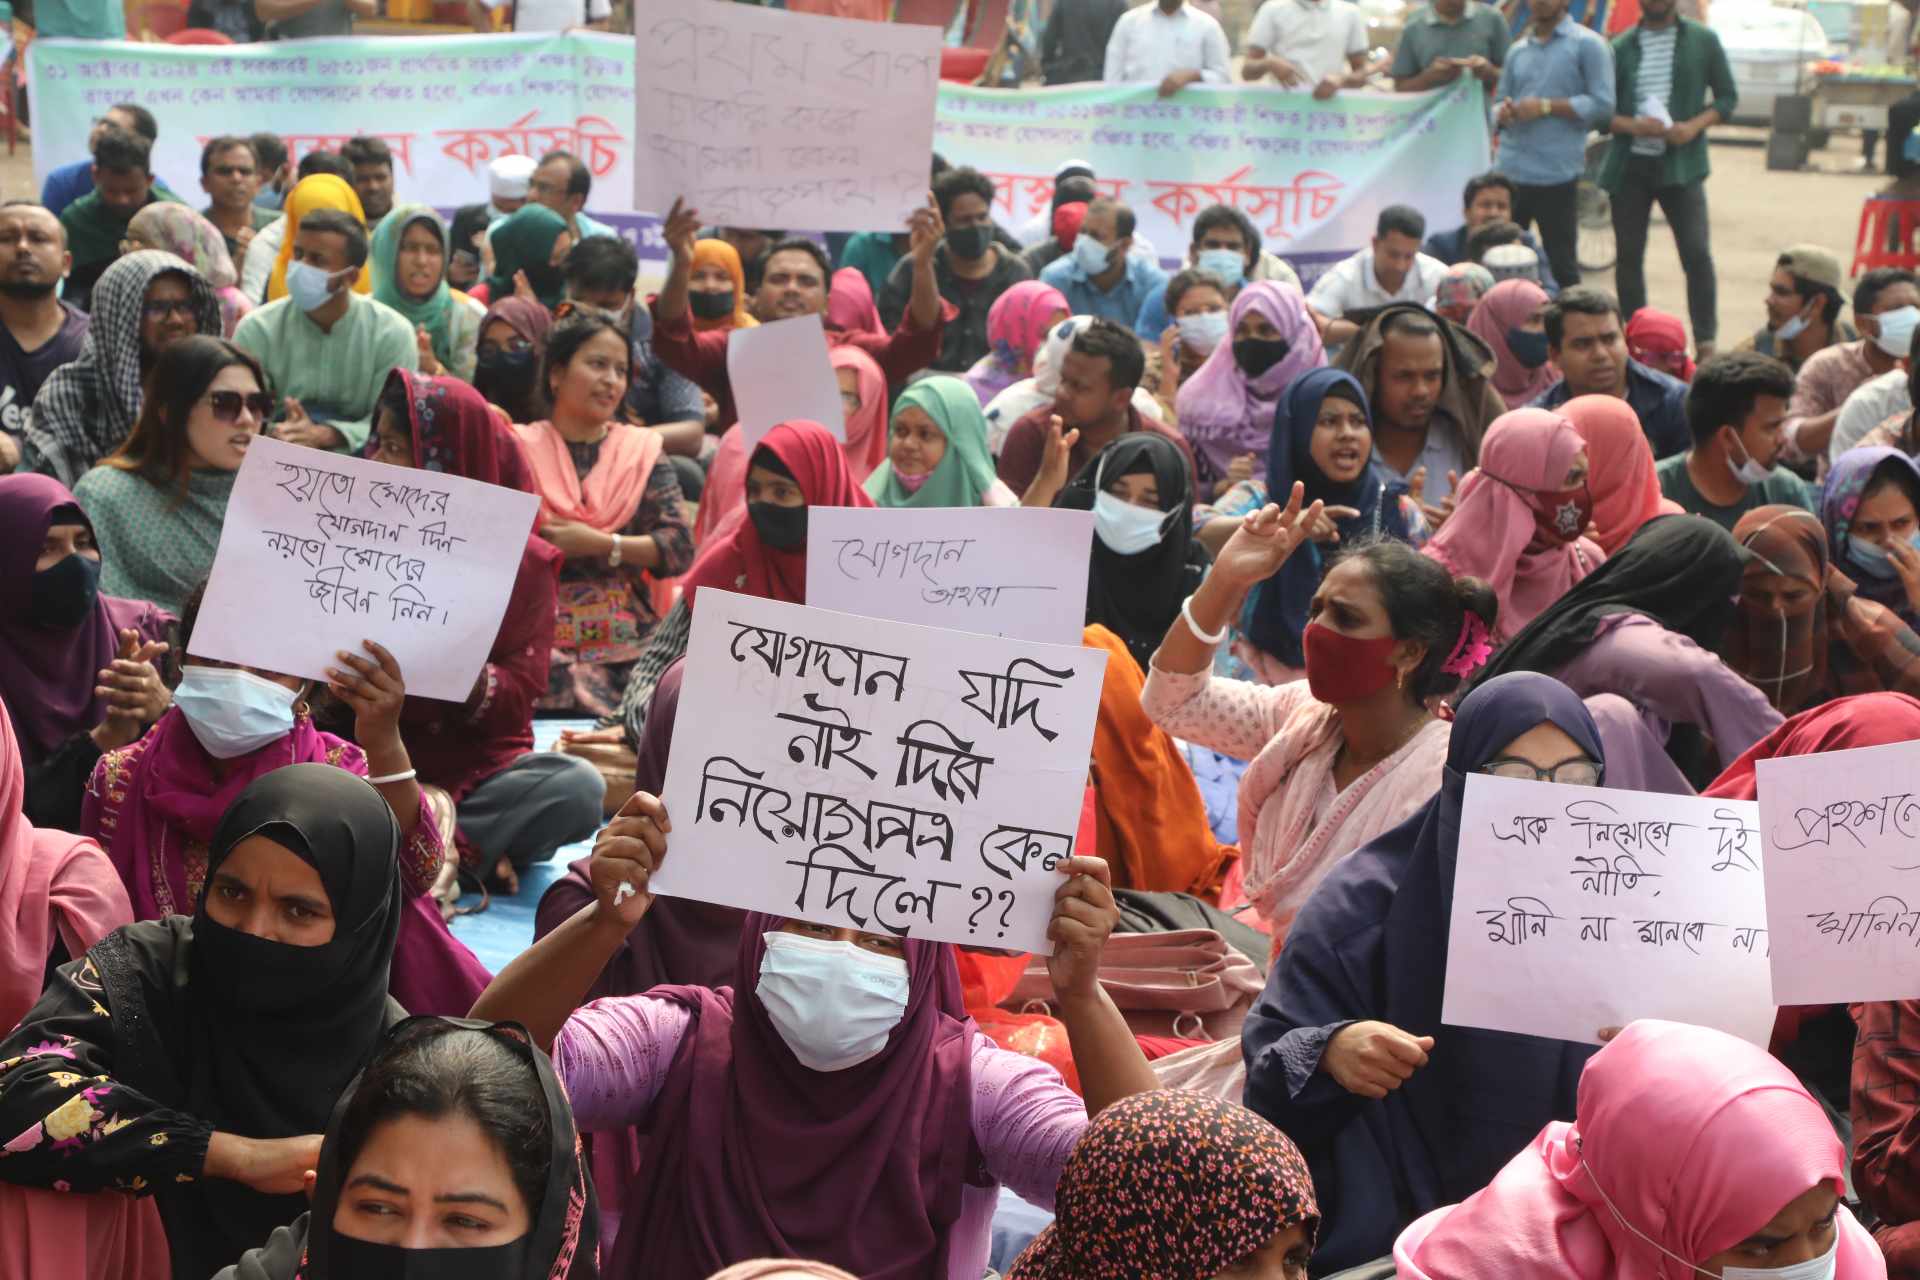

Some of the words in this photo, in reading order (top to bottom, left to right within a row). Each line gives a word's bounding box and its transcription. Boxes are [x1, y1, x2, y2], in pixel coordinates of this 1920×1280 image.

[369, 480, 451, 518] মোদের
[315, 511, 409, 544] যোগদান
[419, 521, 467, 553] দিন
[832, 538, 977, 585] যোগদান
[304, 566, 378, 616] জীবন
[727, 621, 910, 702] যোগদান
[958, 658, 1075, 742] যদি
[775, 693, 878, 781] নাই
[979, 823, 1073, 881] কেন
[1491, 815, 1555, 846] এক
[1476, 896, 1567, 946] মানি
[1580, 917, 1616, 942] না
